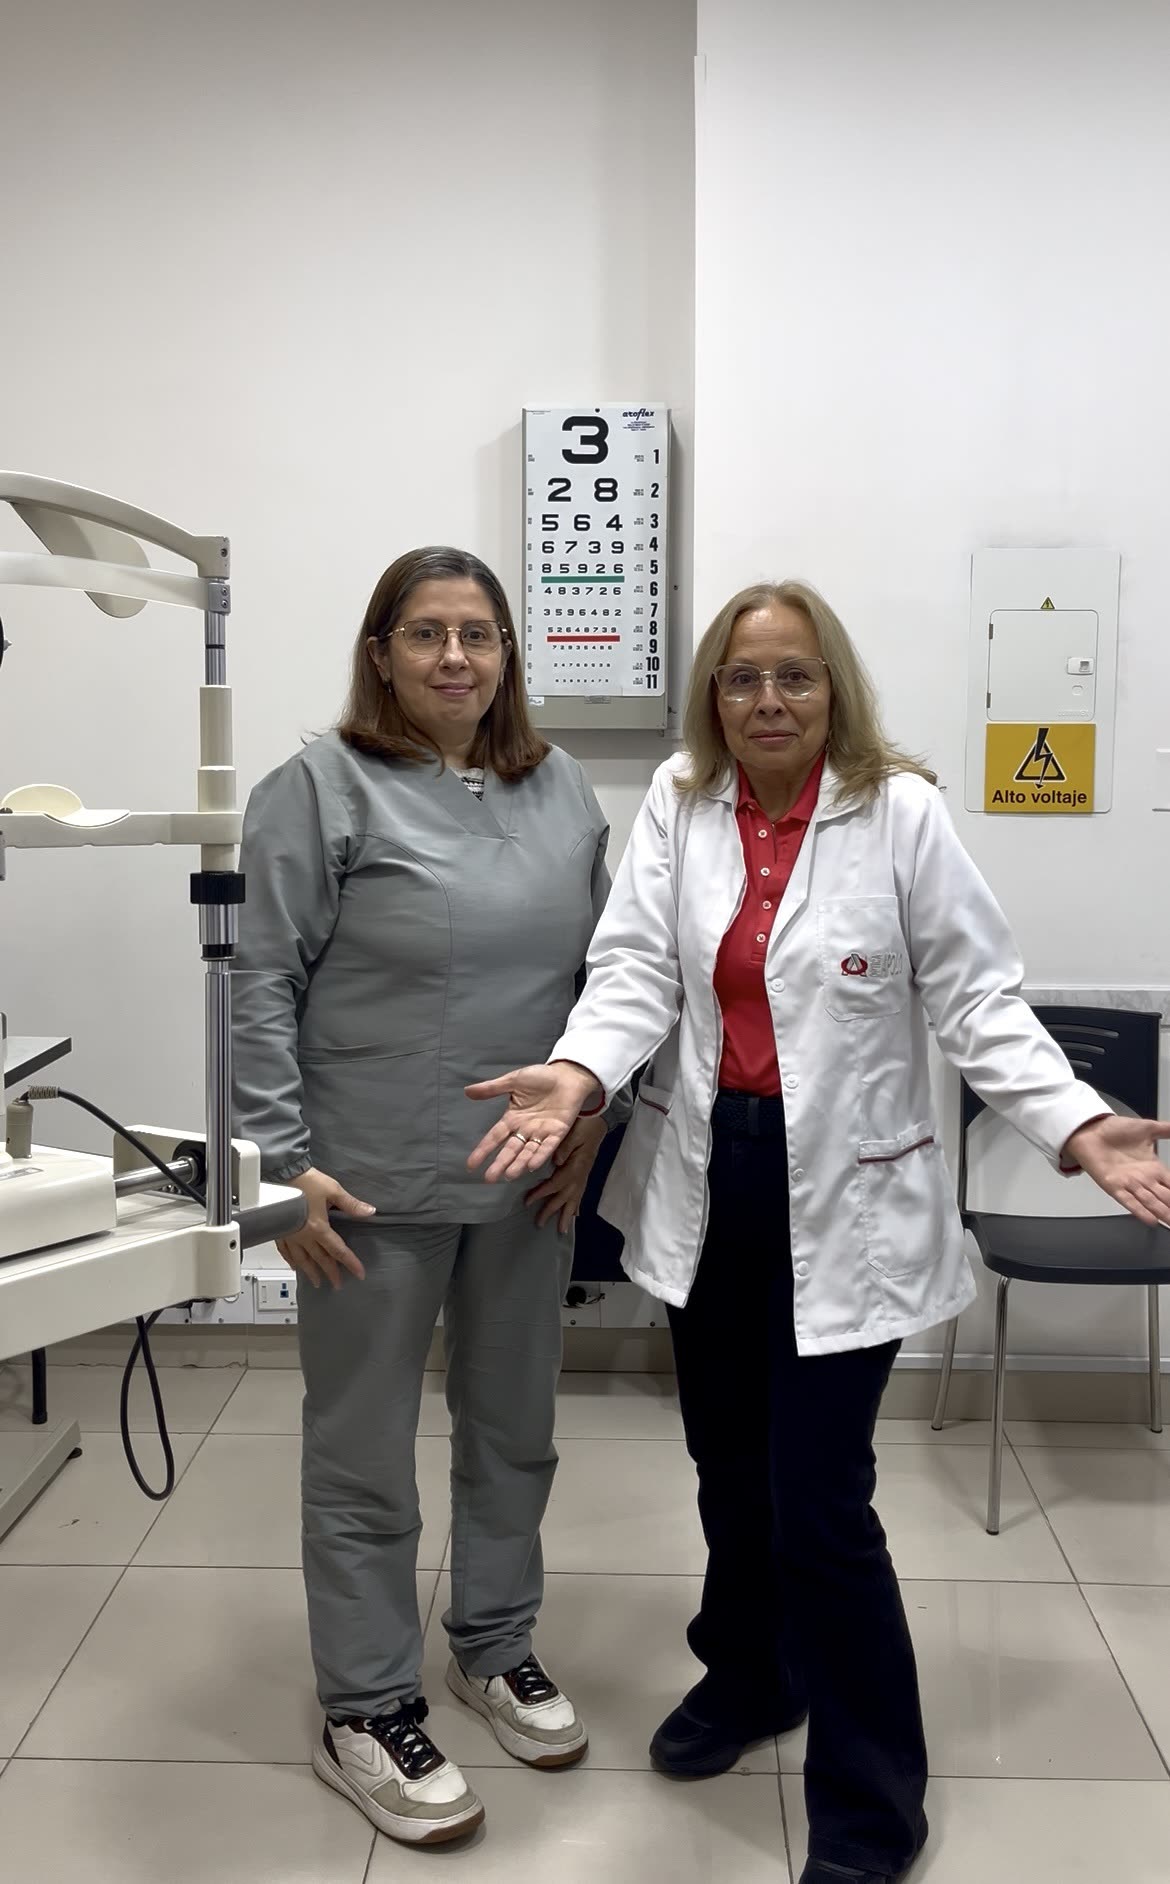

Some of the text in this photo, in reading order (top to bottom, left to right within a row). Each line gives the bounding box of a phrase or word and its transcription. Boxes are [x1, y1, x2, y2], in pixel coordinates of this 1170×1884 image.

[561, 415, 609, 465] 3
[653, 449, 660, 464] 1
[547, 477, 619, 503] 2 8
[651, 483, 659, 498] 2
[541, 513, 560, 532] 5
[573, 513, 591, 532] 6
[605, 513, 623, 532] 4
[650, 513, 659, 529] 3
[541, 540, 555, 554] 6
[564, 540, 578, 554] 7
[588, 540, 602, 554] 3
[611, 540, 625, 555] 9
[649, 537, 658, 551] 4
[541, 563, 552, 574] 8
[559, 563, 570, 574] 5
[577, 563, 588, 574] 9
[595, 563, 606, 575] 2
[613, 563, 624, 574] 6
[650, 560, 658, 574] 5
[544, 586, 553, 595] 4
[557, 586, 567, 596] 8
[571, 586, 581, 596] 3
[585, 586, 594, 596] 7
[599, 586, 608, 596] 2
[612, 586, 622, 596] 6
[650, 582, 658, 596] 6
[543, 608, 622, 617] 3 5 9 6 4 8 2
[650, 603, 658, 617] 7
[649, 621, 657, 635] 8
[649, 639, 657, 654] 9
[646, 656, 660, 671] 10
[646, 674, 658, 689] 11
[991, 789, 1088, 808] Alto voltaje
